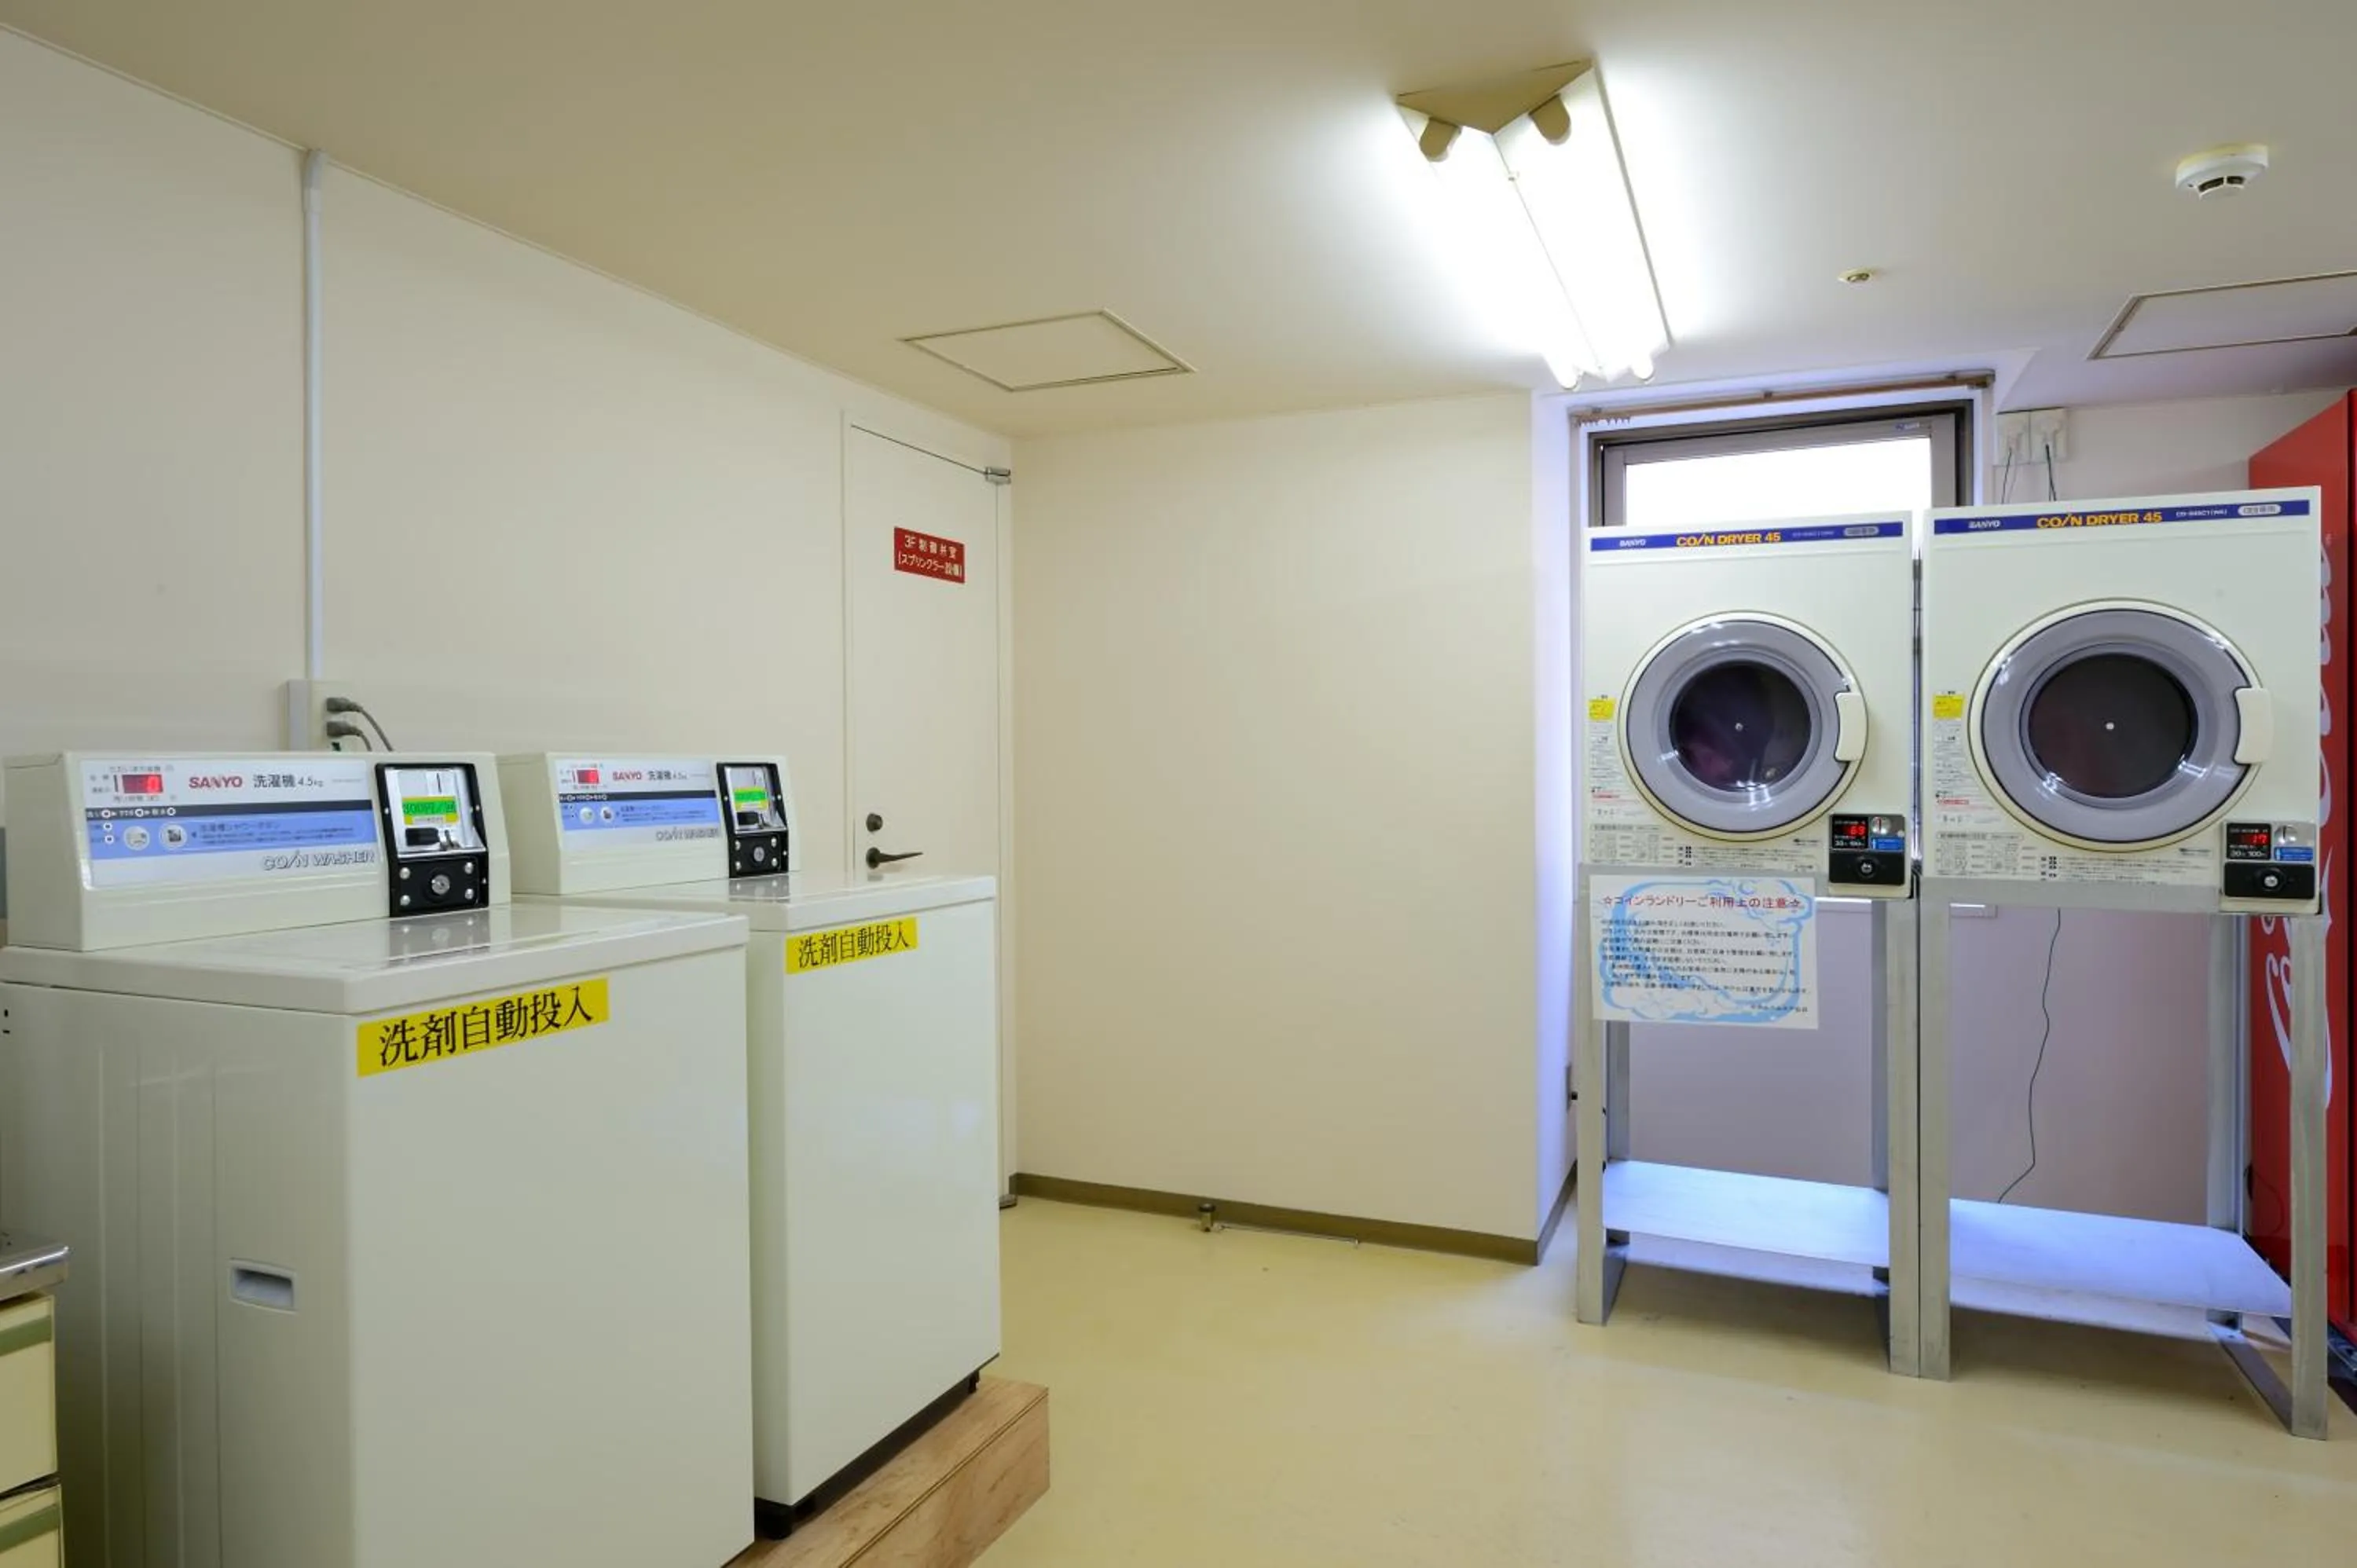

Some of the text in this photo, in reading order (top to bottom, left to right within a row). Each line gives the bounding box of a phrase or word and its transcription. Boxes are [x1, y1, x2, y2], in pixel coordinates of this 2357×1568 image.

[1968, 519, 2001, 529] SANYO
[2086, 512, 2139, 526] DRYER
[2143, 511, 2163, 523] 45
[1717, 533, 1761, 545] DRYER
[1765, 532, 1781, 542] 45
[189, 775, 243, 789] SANYO
[613, 771, 642, 782] SANYO
[314, 849, 376, 866] WASHER
[799, 920, 910, 969] 洗剤自動投入
[379, 985, 594, 1067] 洗剤自動投入
